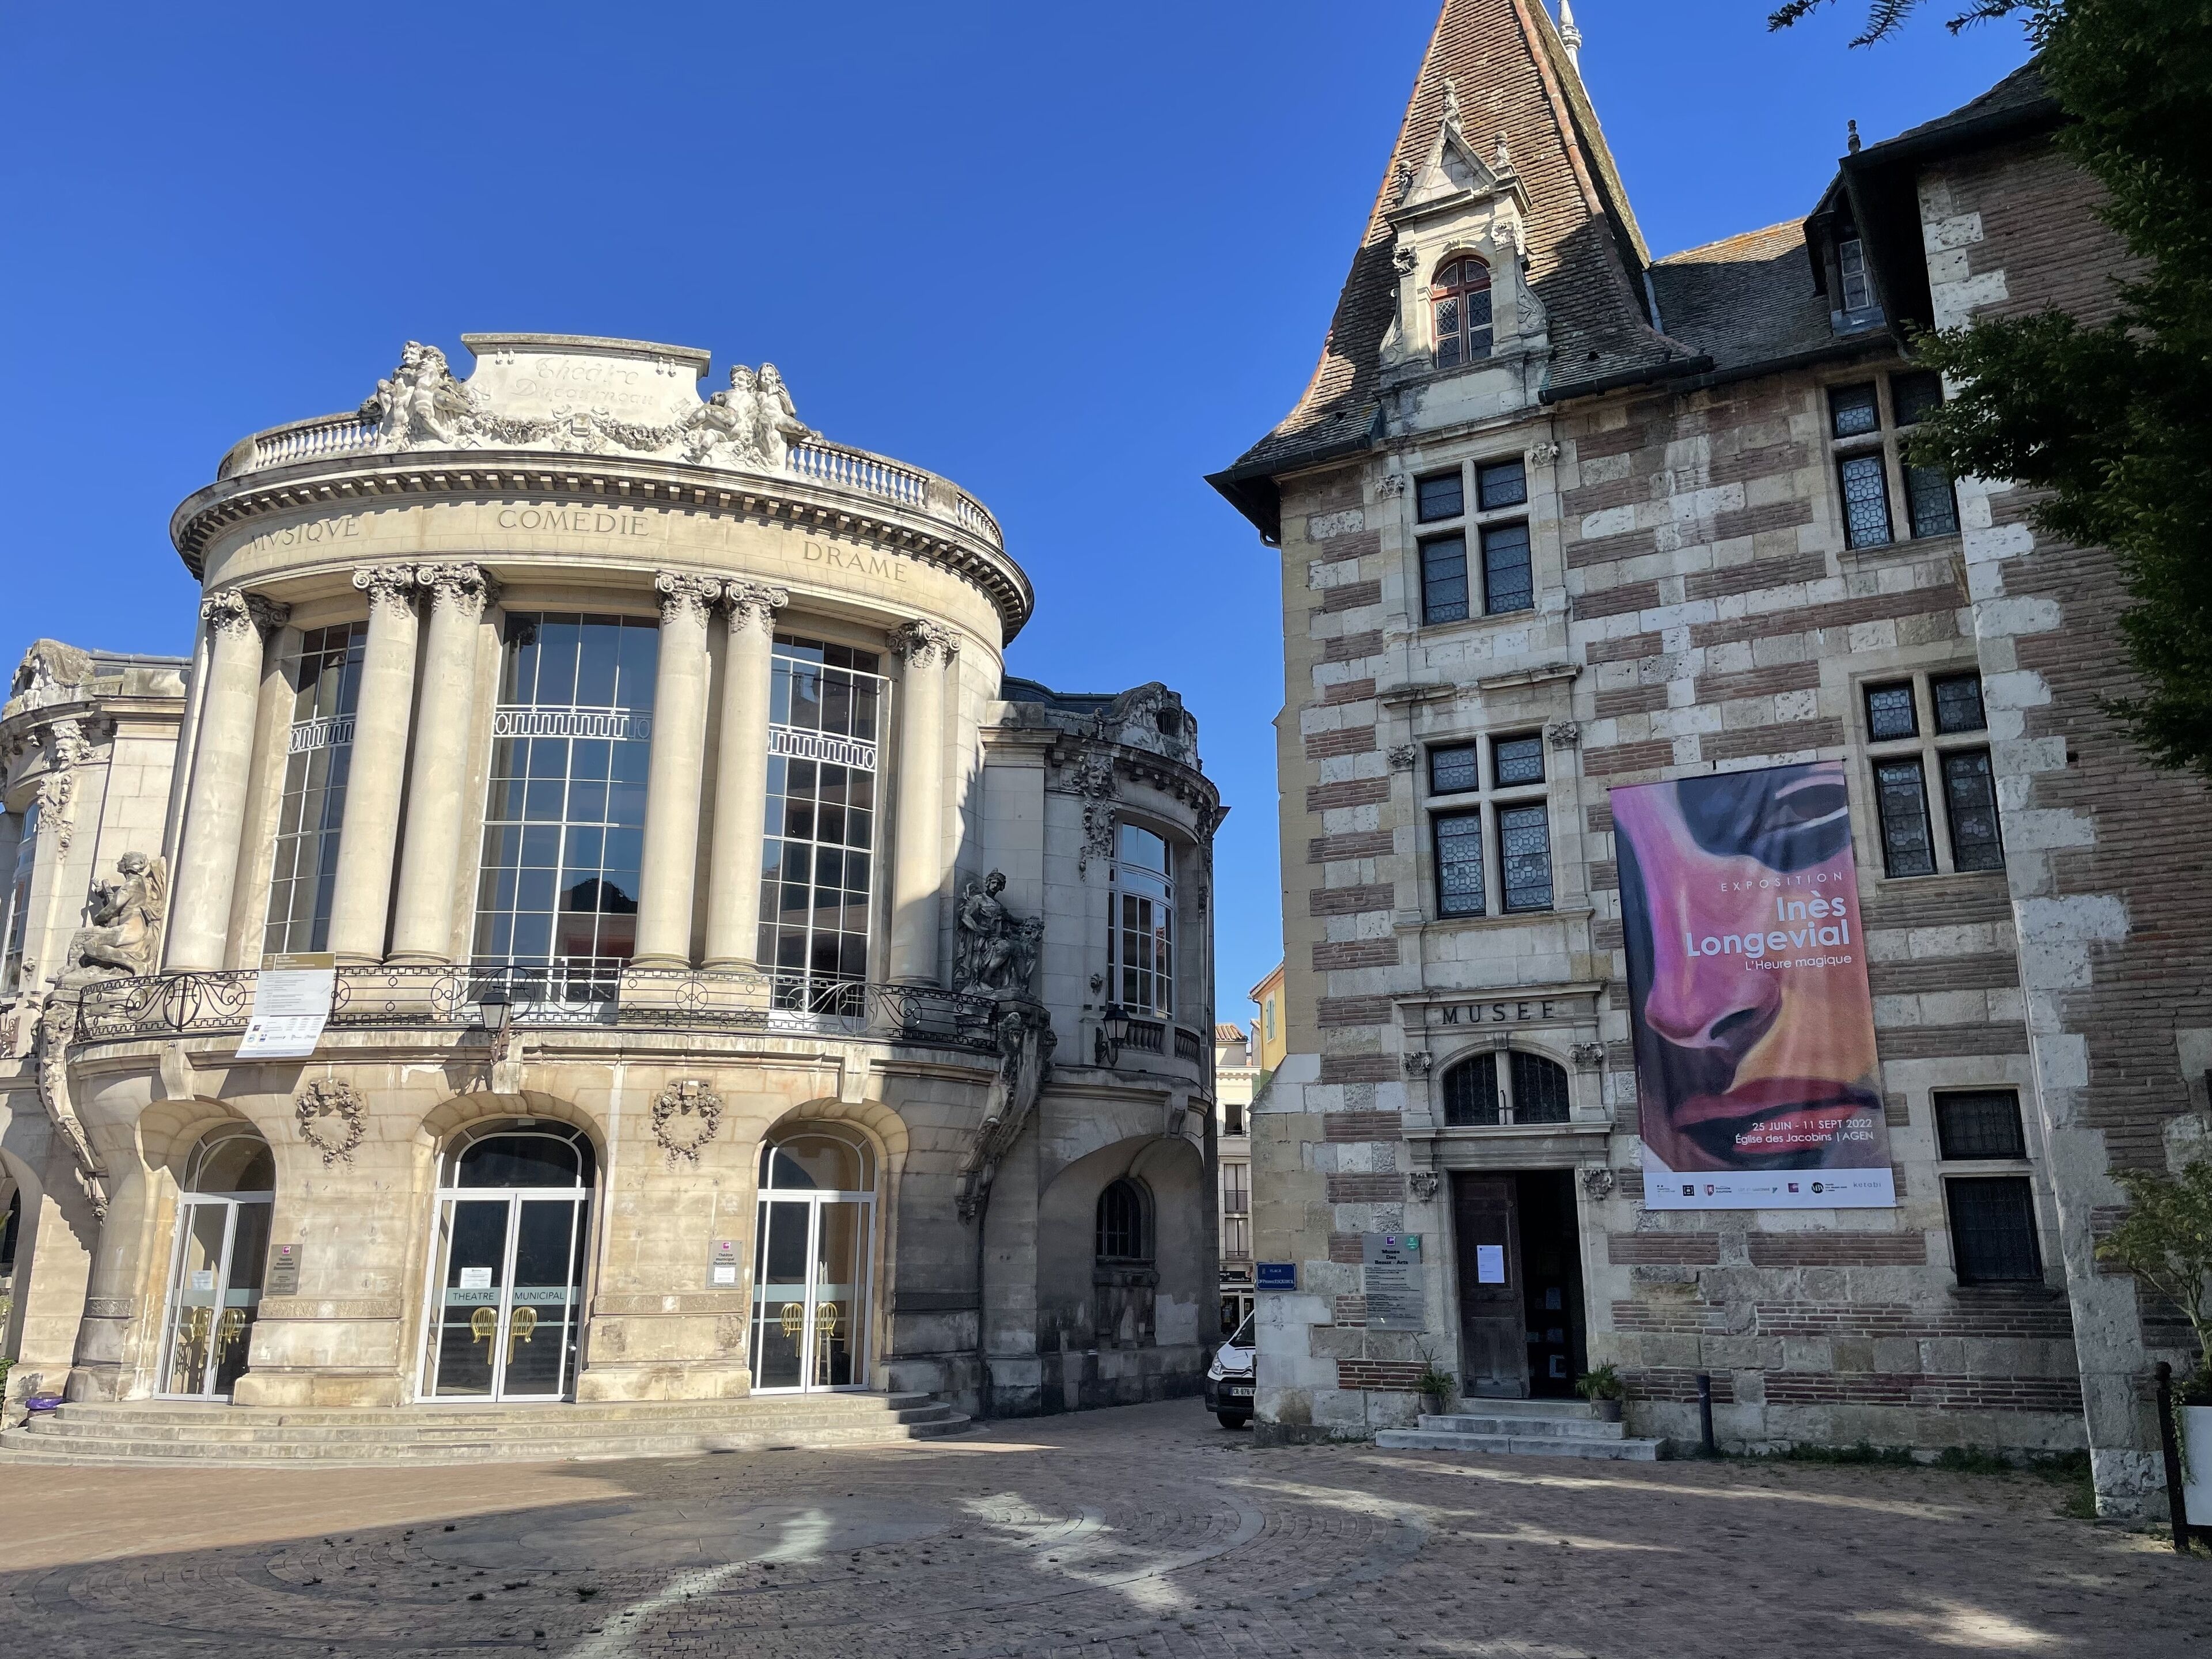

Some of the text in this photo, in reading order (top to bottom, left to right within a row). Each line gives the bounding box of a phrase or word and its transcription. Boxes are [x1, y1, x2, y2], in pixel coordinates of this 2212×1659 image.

[497, 509, 650, 537] COMEDIE
[802, 540, 908, 583] DRAME
[1721, 871, 1843, 892] EXPOSITION
[1776, 889, 1847, 922] Inès
[1685, 918, 1850, 959] Longevial
[1745, 954, 1852, 971] L'Heure magique
[1442, 999, 1555, 1025] MUSEE
[1752, 1122, 1765, 1131] 25
[1768, 1122, 1792, 1131] JUIN
[1803, 1120, 1814, 1130] 11
[1818, 1120, 1843, 1129] SEPT
[1846, 1119, 1873, 1128] 2022
[1765, 1133, 1783, 1143] des
[1786, 1132, 1832, 1143] Jacobins
[1842, 1131, 1873, 1141] AGEN
[453, 1291, 565, 1301] THEATRE MUNICIPAL
